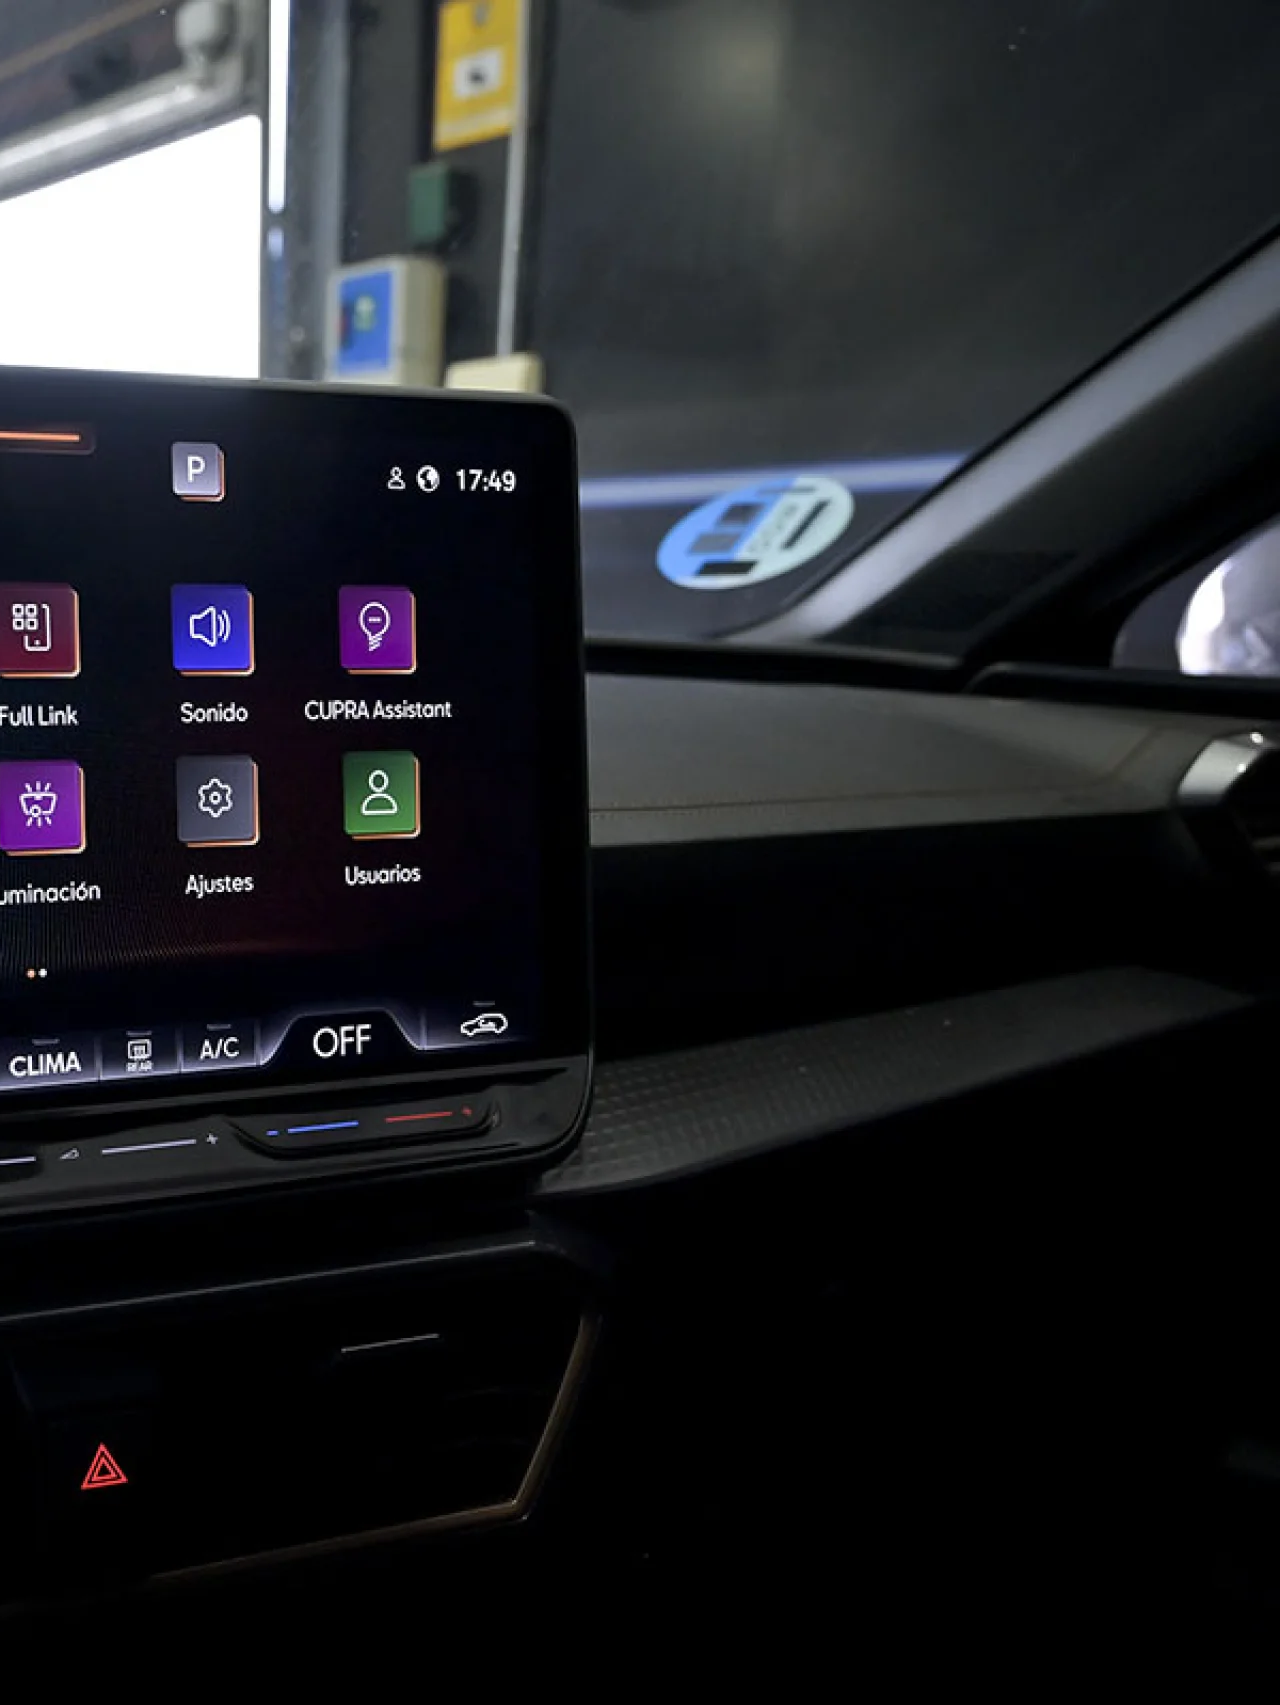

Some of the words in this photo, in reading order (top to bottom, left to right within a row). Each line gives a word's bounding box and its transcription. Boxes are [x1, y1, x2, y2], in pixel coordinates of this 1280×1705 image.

[186, 456, 206, 483] P
[455, 467, 517, 493] 17:49
[37, 704, 78, 728] Link
[180, 700, 248, 724] Sonido
[304, 699, 370, 721] CUPRA
[371, 699, 453, 720] Assistant
[185, 873, 255, 899] Ajustes
[344, 863, 421, 886] Usuarios
[198, 1036, 241, 1060] A/C
[312, 1022, 372, 1058] OFF
[8, 1050, 82, 1077] CLIMA
